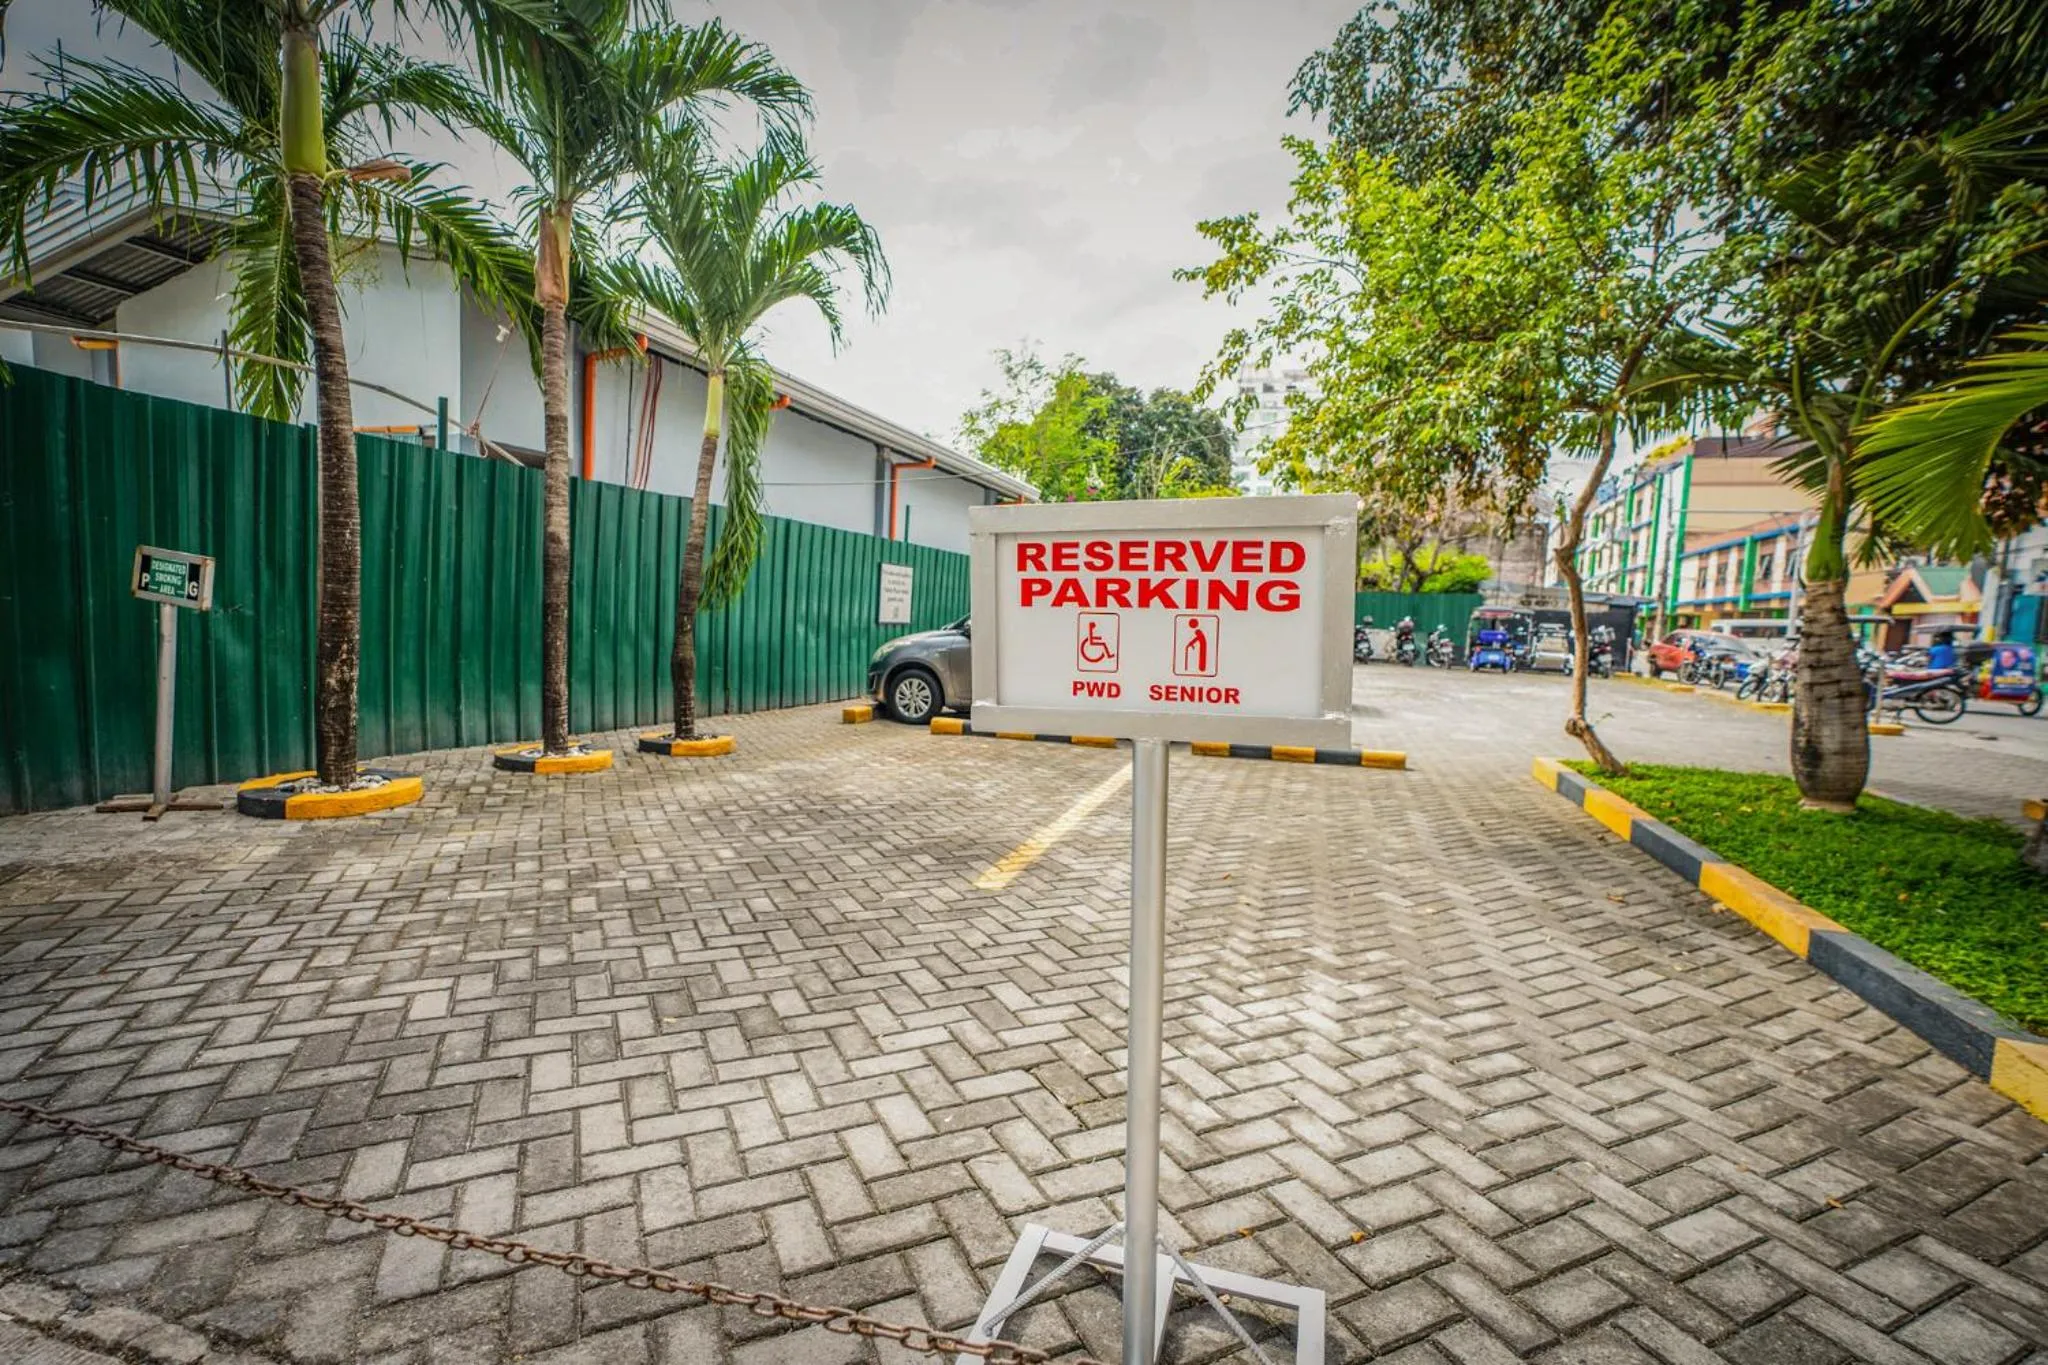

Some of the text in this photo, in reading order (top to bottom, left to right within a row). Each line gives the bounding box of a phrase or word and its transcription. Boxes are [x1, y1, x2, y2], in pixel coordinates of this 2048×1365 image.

[1017, 540, 1306, 573] RESERVED
[151, 560, 187, 576] DESIGNATED
[154, 572, 182, 586] SMOKING
[160, 584, 176, 596] AREA
[1020, 578, 1301, 612] PARKING
[1072, 680, 1240, 705] PWD SENIOR
